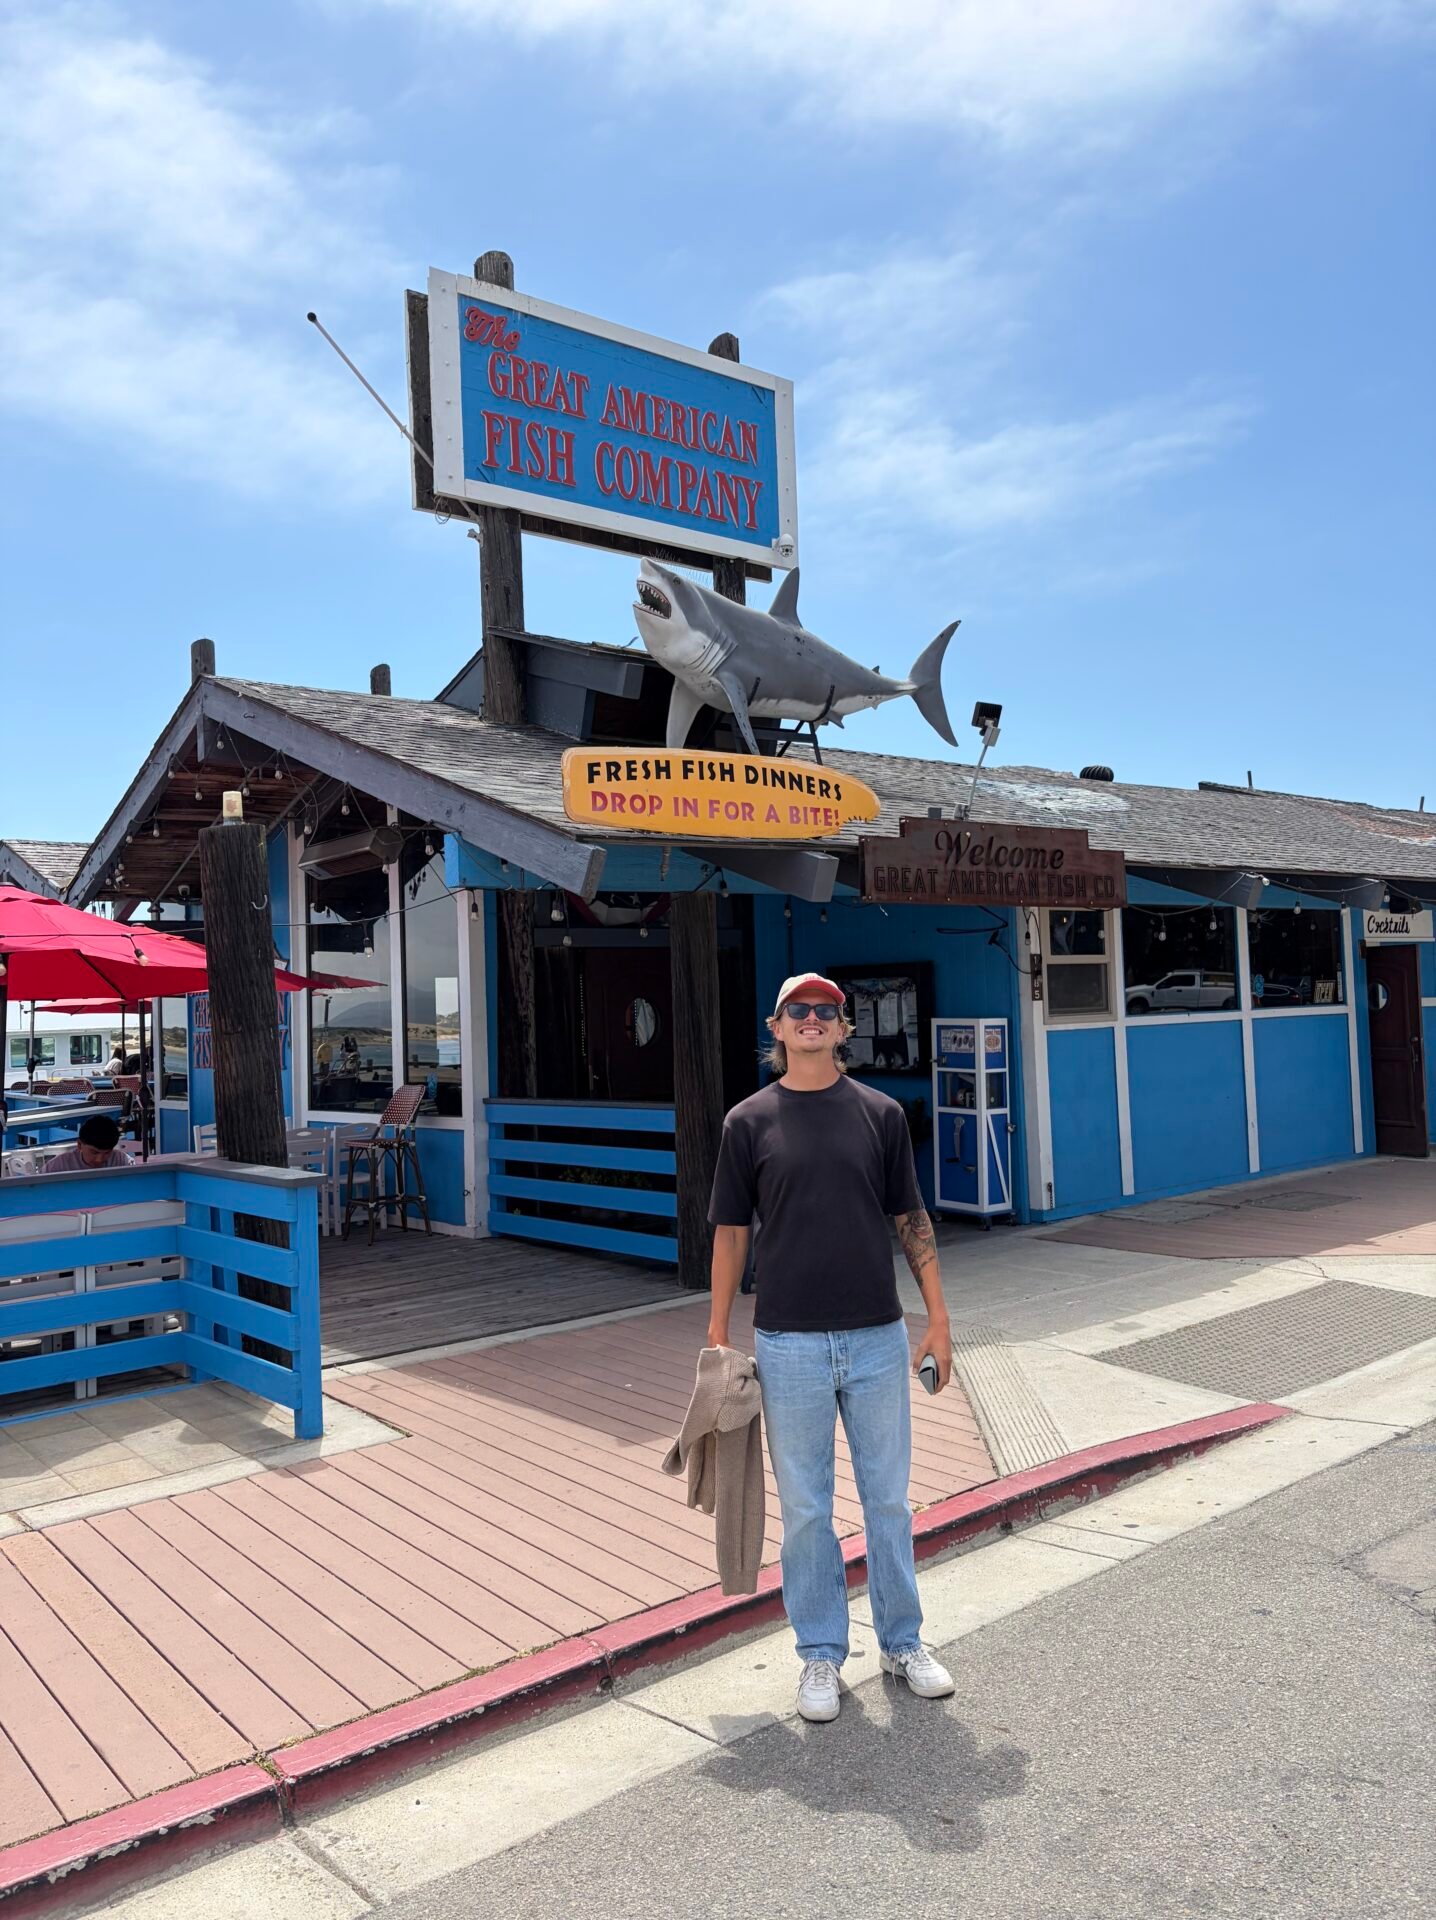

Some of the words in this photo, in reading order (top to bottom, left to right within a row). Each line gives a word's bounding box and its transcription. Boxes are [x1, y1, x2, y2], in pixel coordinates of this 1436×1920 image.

[464, 306, 520, 352] The
[488, 352, 590, 419] GREAT
[600, 384, 758, 467] AMERICAN
[481, 410, 577, 487] FISH
[595, 441, 763, 529] COMPANY
[587, 760, 671, 784] FRESH
[682, 760, 735, 782] FISH
[744, 765, 842, 801] DINNERS
[591, 791, 663, 815] DROP
[673, 797, 698, 818] IN
[708, 800, 754, 821] FOR
[765, 804, 781, 823] A
[789, 806, 839, 827] BITE!
[934, 830, 1064, 870] Welcome
[873, 866, 938, 893] GREAT
[949, 870, 1040, 897] AMERICAN
[1048, 873, 1086, 898] FISH
[1367, 915, 1410, 934] Cocktails
